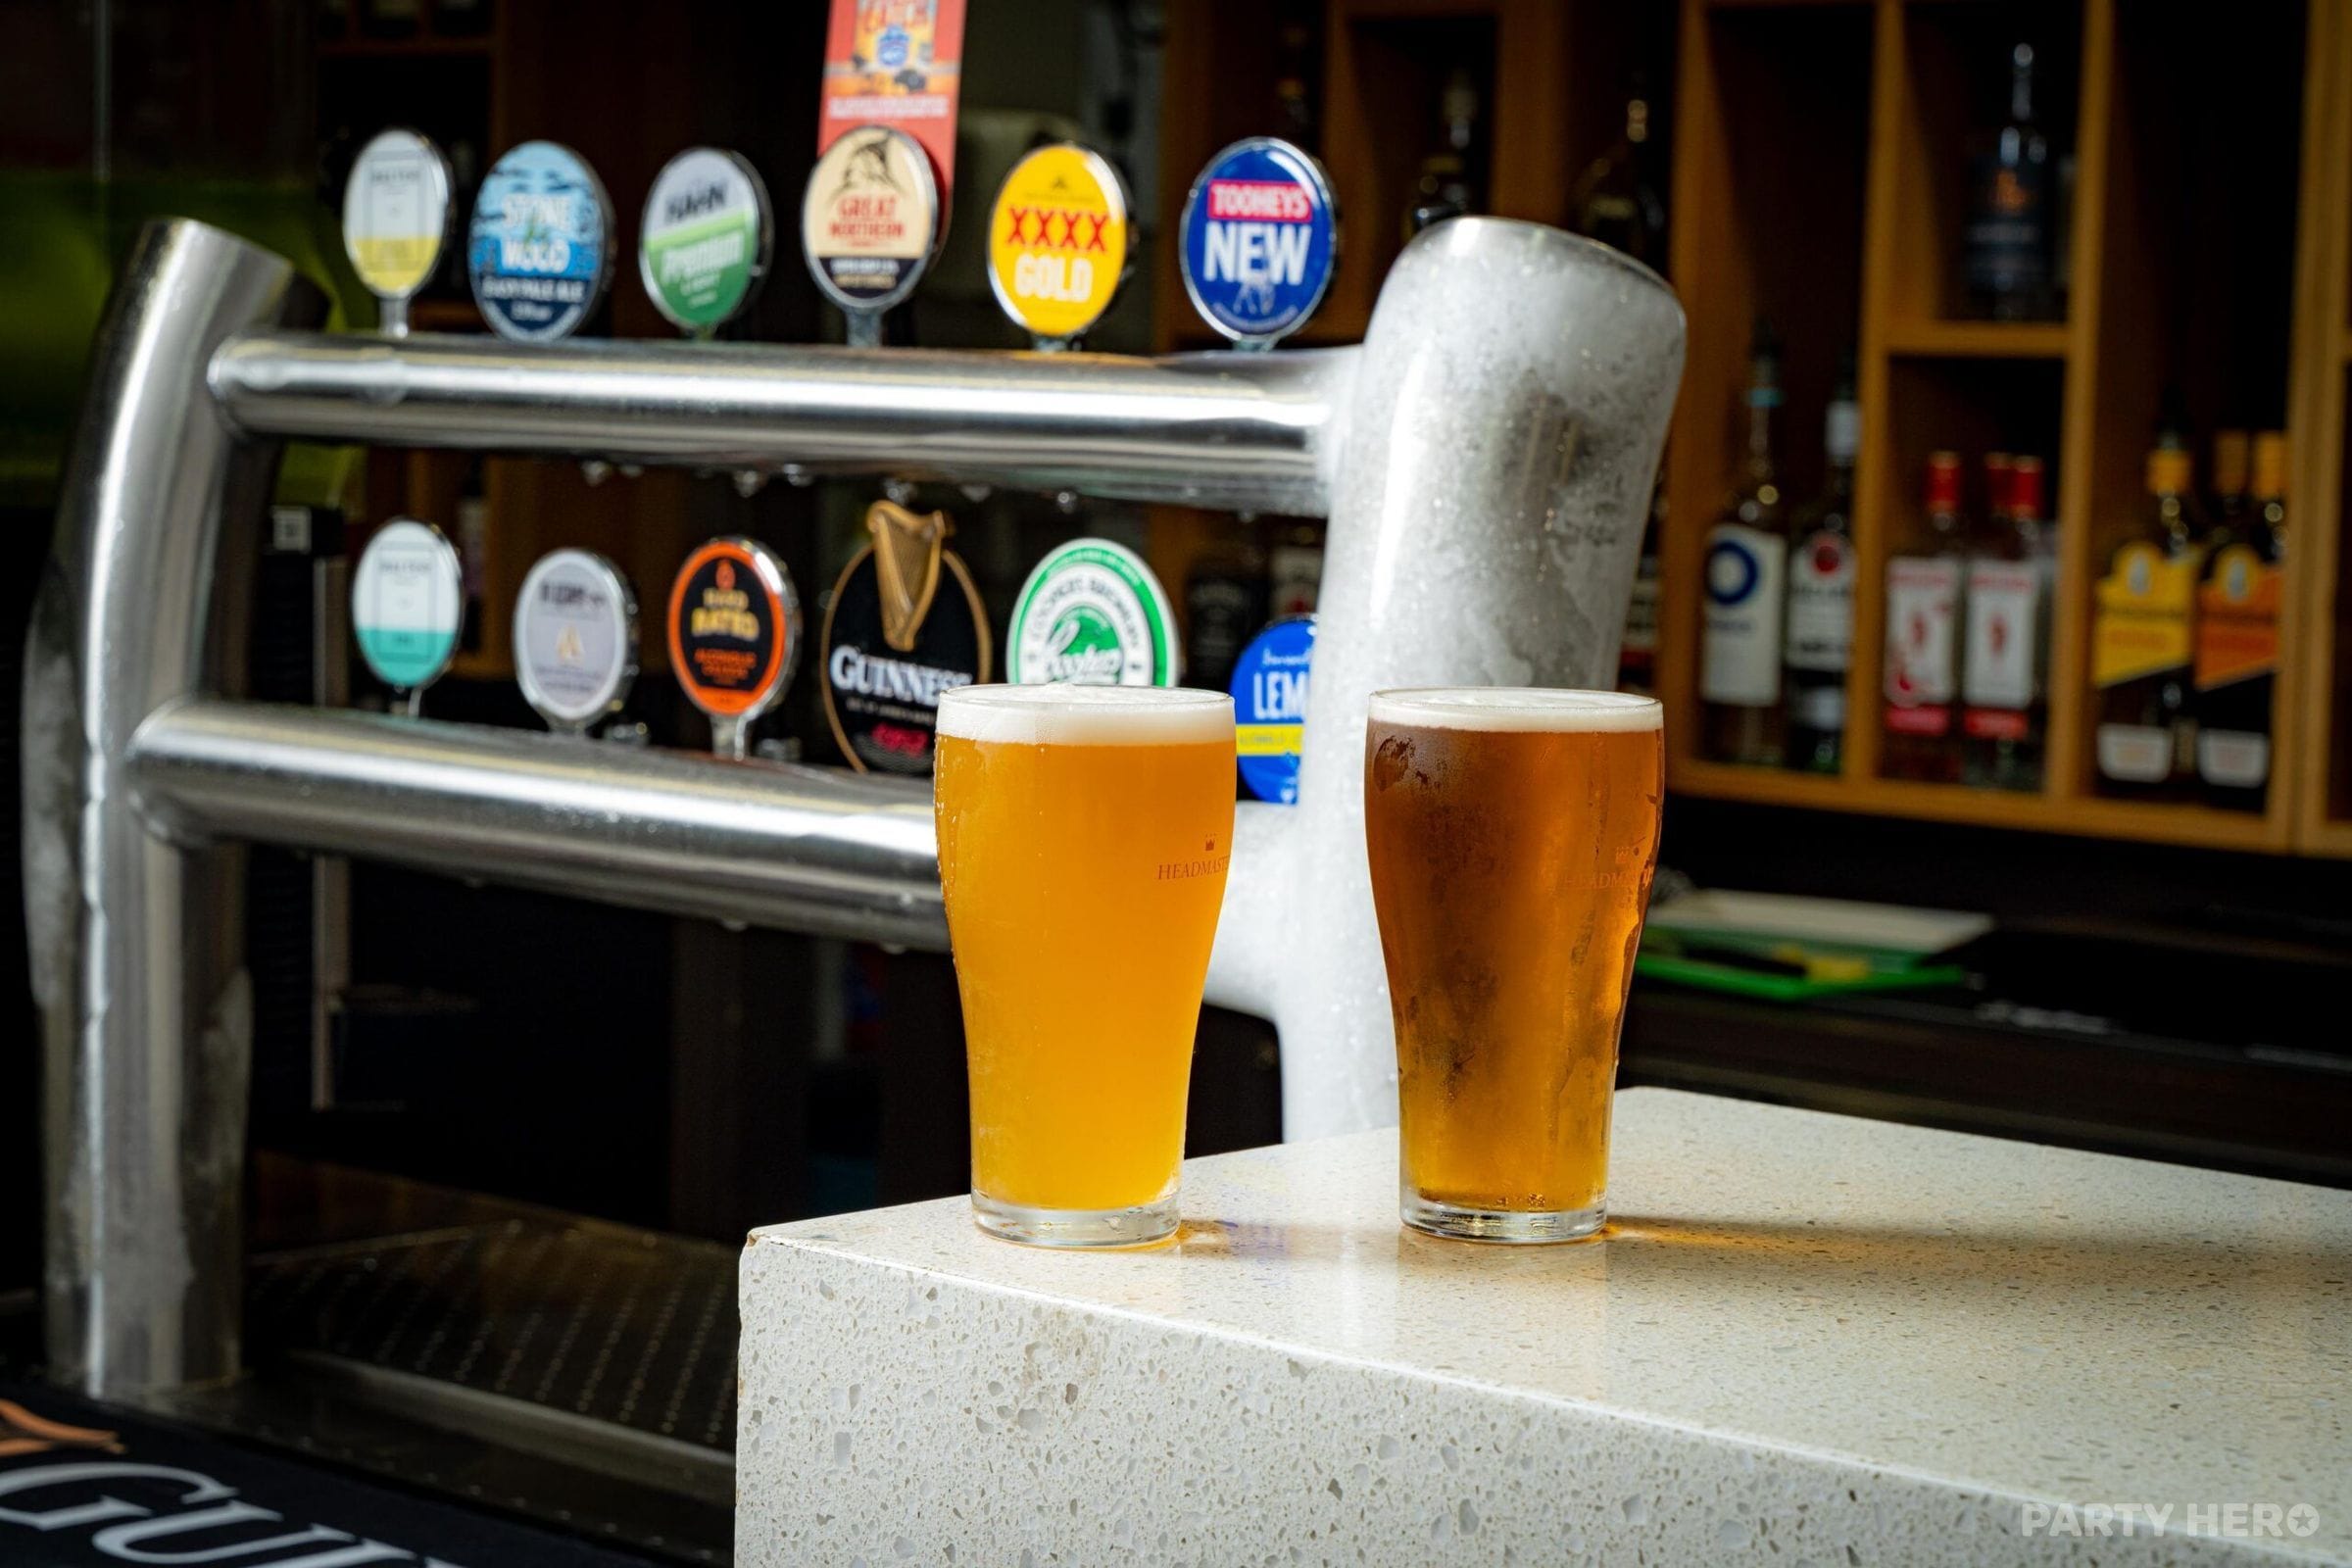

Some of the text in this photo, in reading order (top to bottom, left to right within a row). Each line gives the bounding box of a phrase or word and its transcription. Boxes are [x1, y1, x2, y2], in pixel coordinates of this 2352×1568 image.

[1212, 184, 1307, 220] TOOHEYS
[1007, 207, 1109, 253] XXXX
[1203, 220, 1312, 285] NEW
[1015, 254, 1094, 303] GOLD
